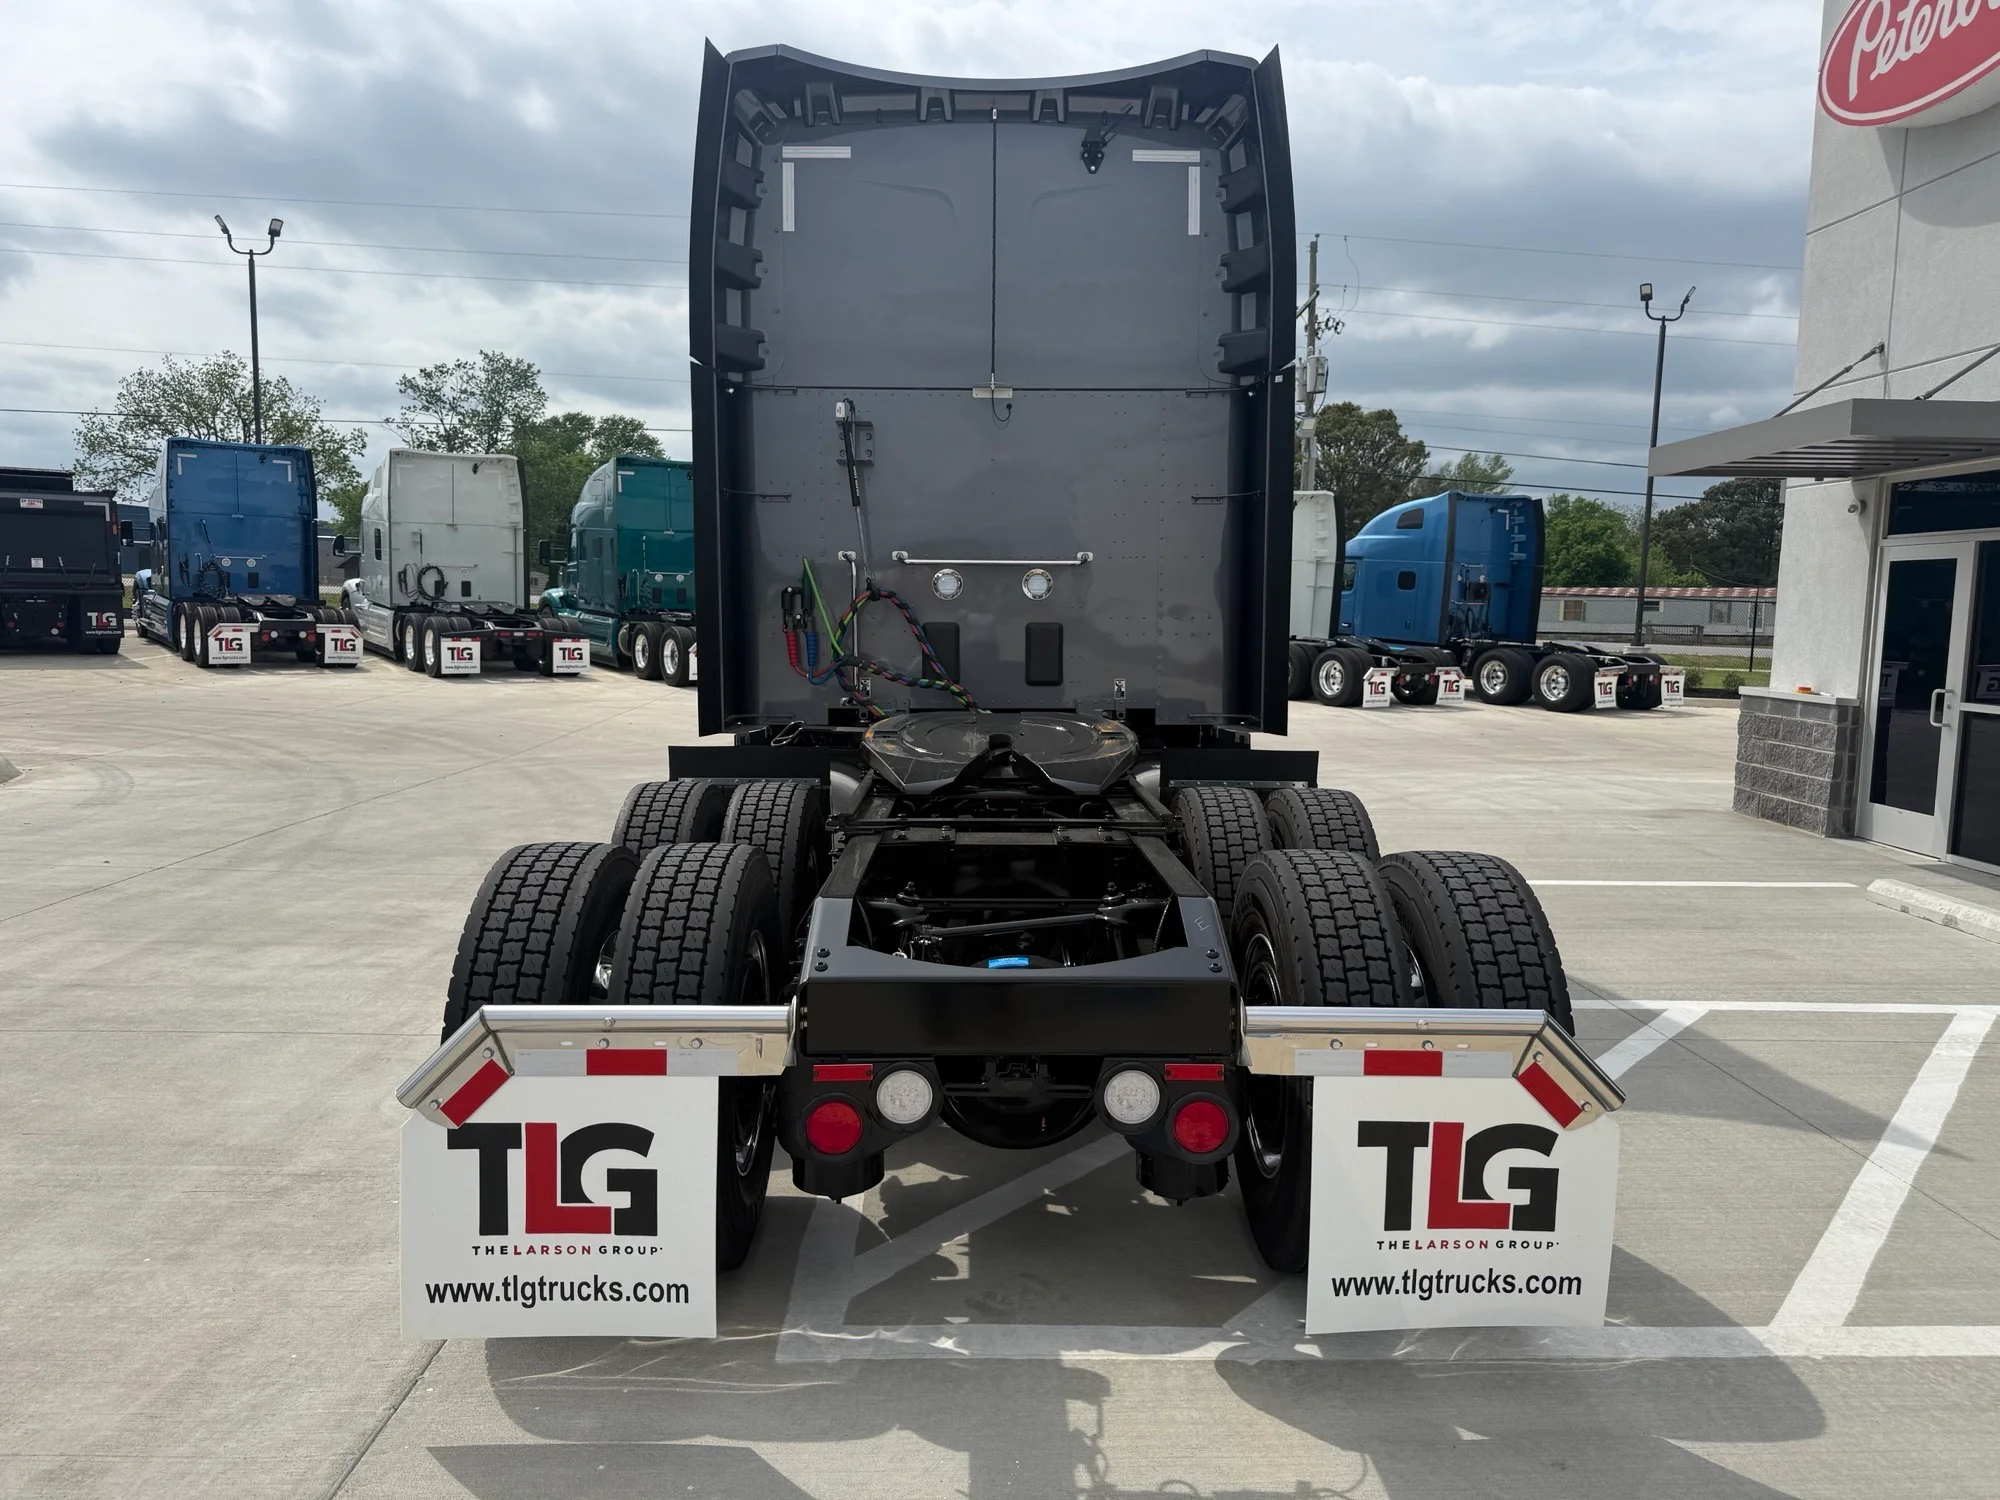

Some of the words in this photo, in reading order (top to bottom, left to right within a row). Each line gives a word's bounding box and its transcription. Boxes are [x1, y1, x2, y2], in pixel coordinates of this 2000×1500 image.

[87, 612, 117, 628] TLG
[215, 637, 243, 651] TLG
[331, 638, 356, 651] TLG
[447, 647, 473, 660] TLG
[559, 647, 583, 660] TLG
[1368, 681, 1386, 695] TLG
[1443, 679, 1460, 692] TLG
[1597, 682, 1613, 695] TLG
[1664, 680, 1680, 693] TLG
[447, 1122, 658, 1236] TLG
[1357, 1120, 1560, 1232] TLG
[598, 1245, 659, 1256] GROUP
[1495, 1240, 1554, 1251] GROUP
[1331, 1268, 1582, 1301] www.tlgtrucks.com
[425, 1275, 690, 1308] www.tlgtrucks.com
